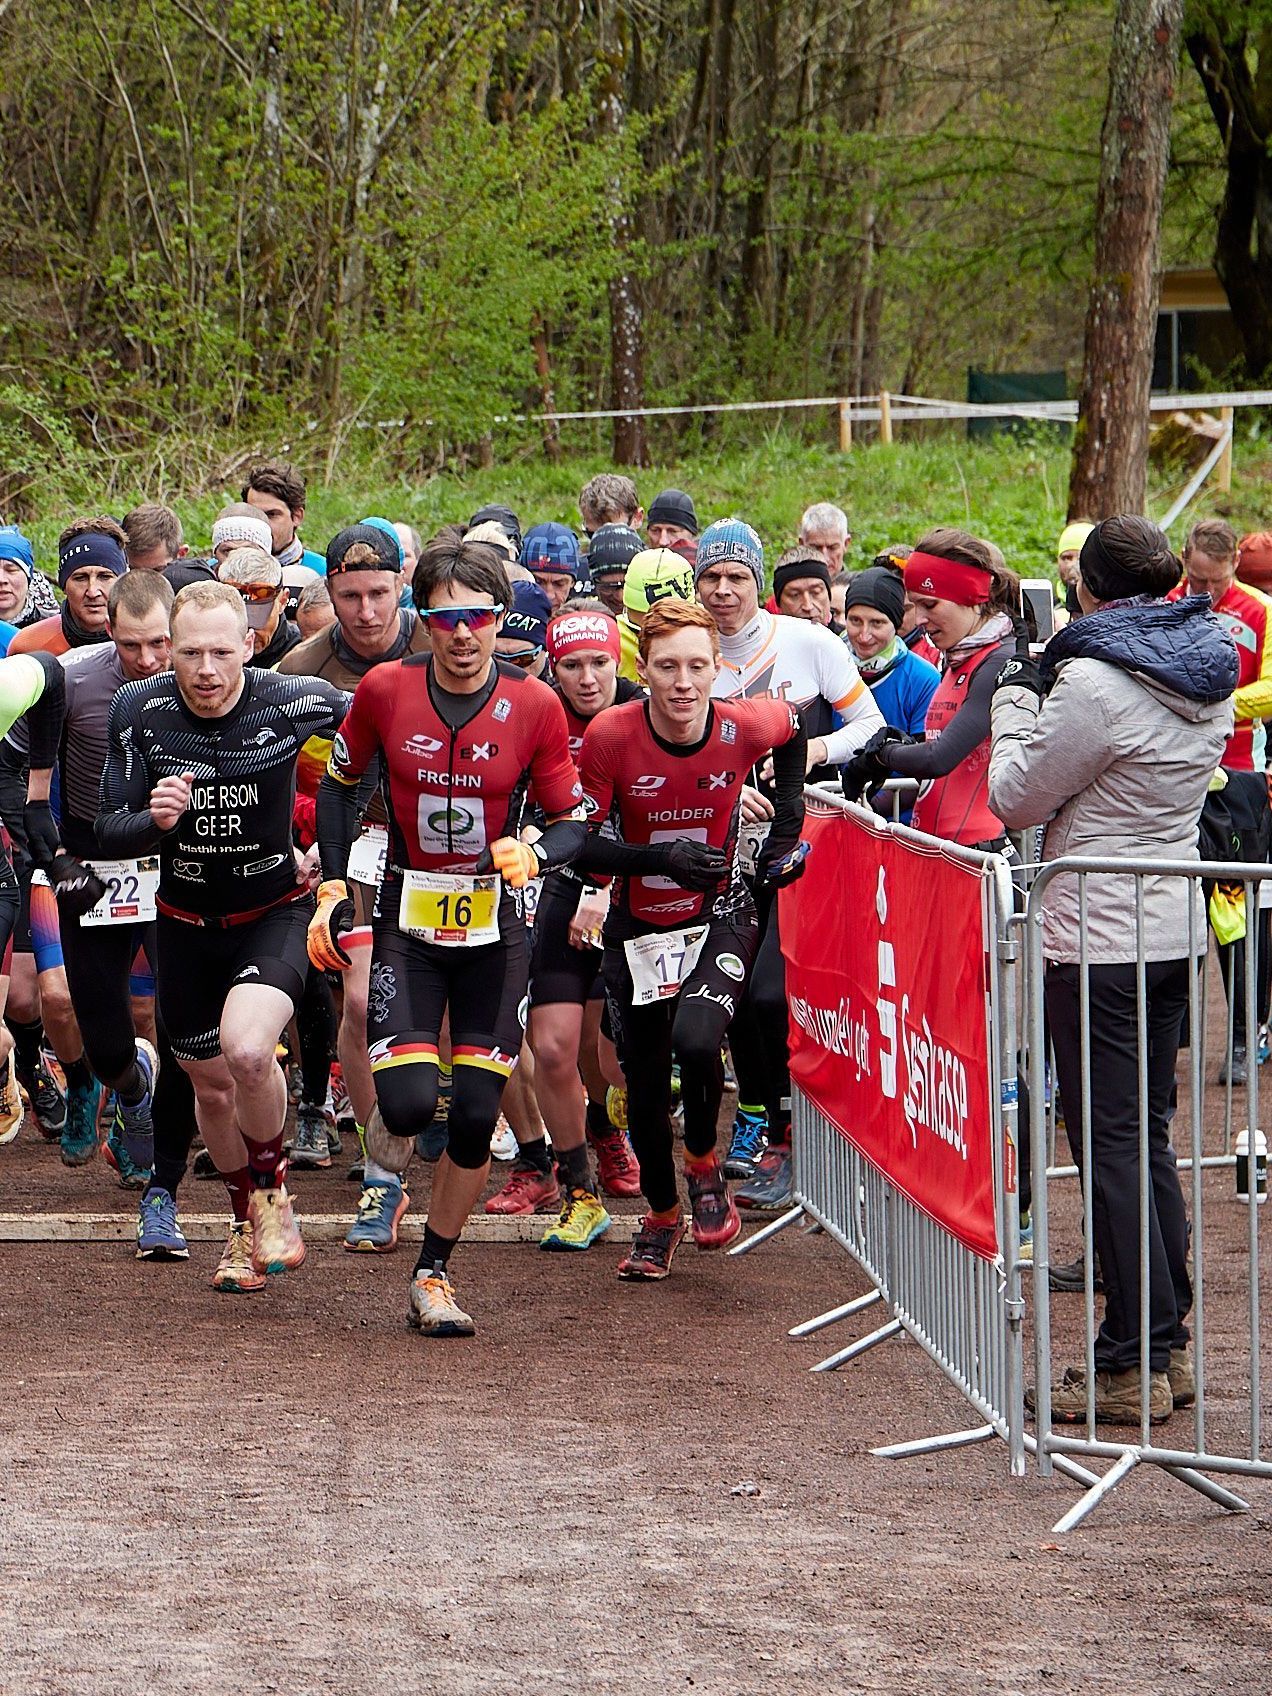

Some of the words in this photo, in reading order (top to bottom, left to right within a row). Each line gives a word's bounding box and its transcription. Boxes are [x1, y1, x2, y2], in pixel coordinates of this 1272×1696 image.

[552, 616, 609, 642] HOKA
[563, 631, 595, 644] HUMAN
[417, 768, 482, 788] FROHN
[647, 808, 714, 822] HOLDER
[107, 876, 140, 904] 22
[437, 895, 472, 927] 16
[656, 952, 685, 982] 17
